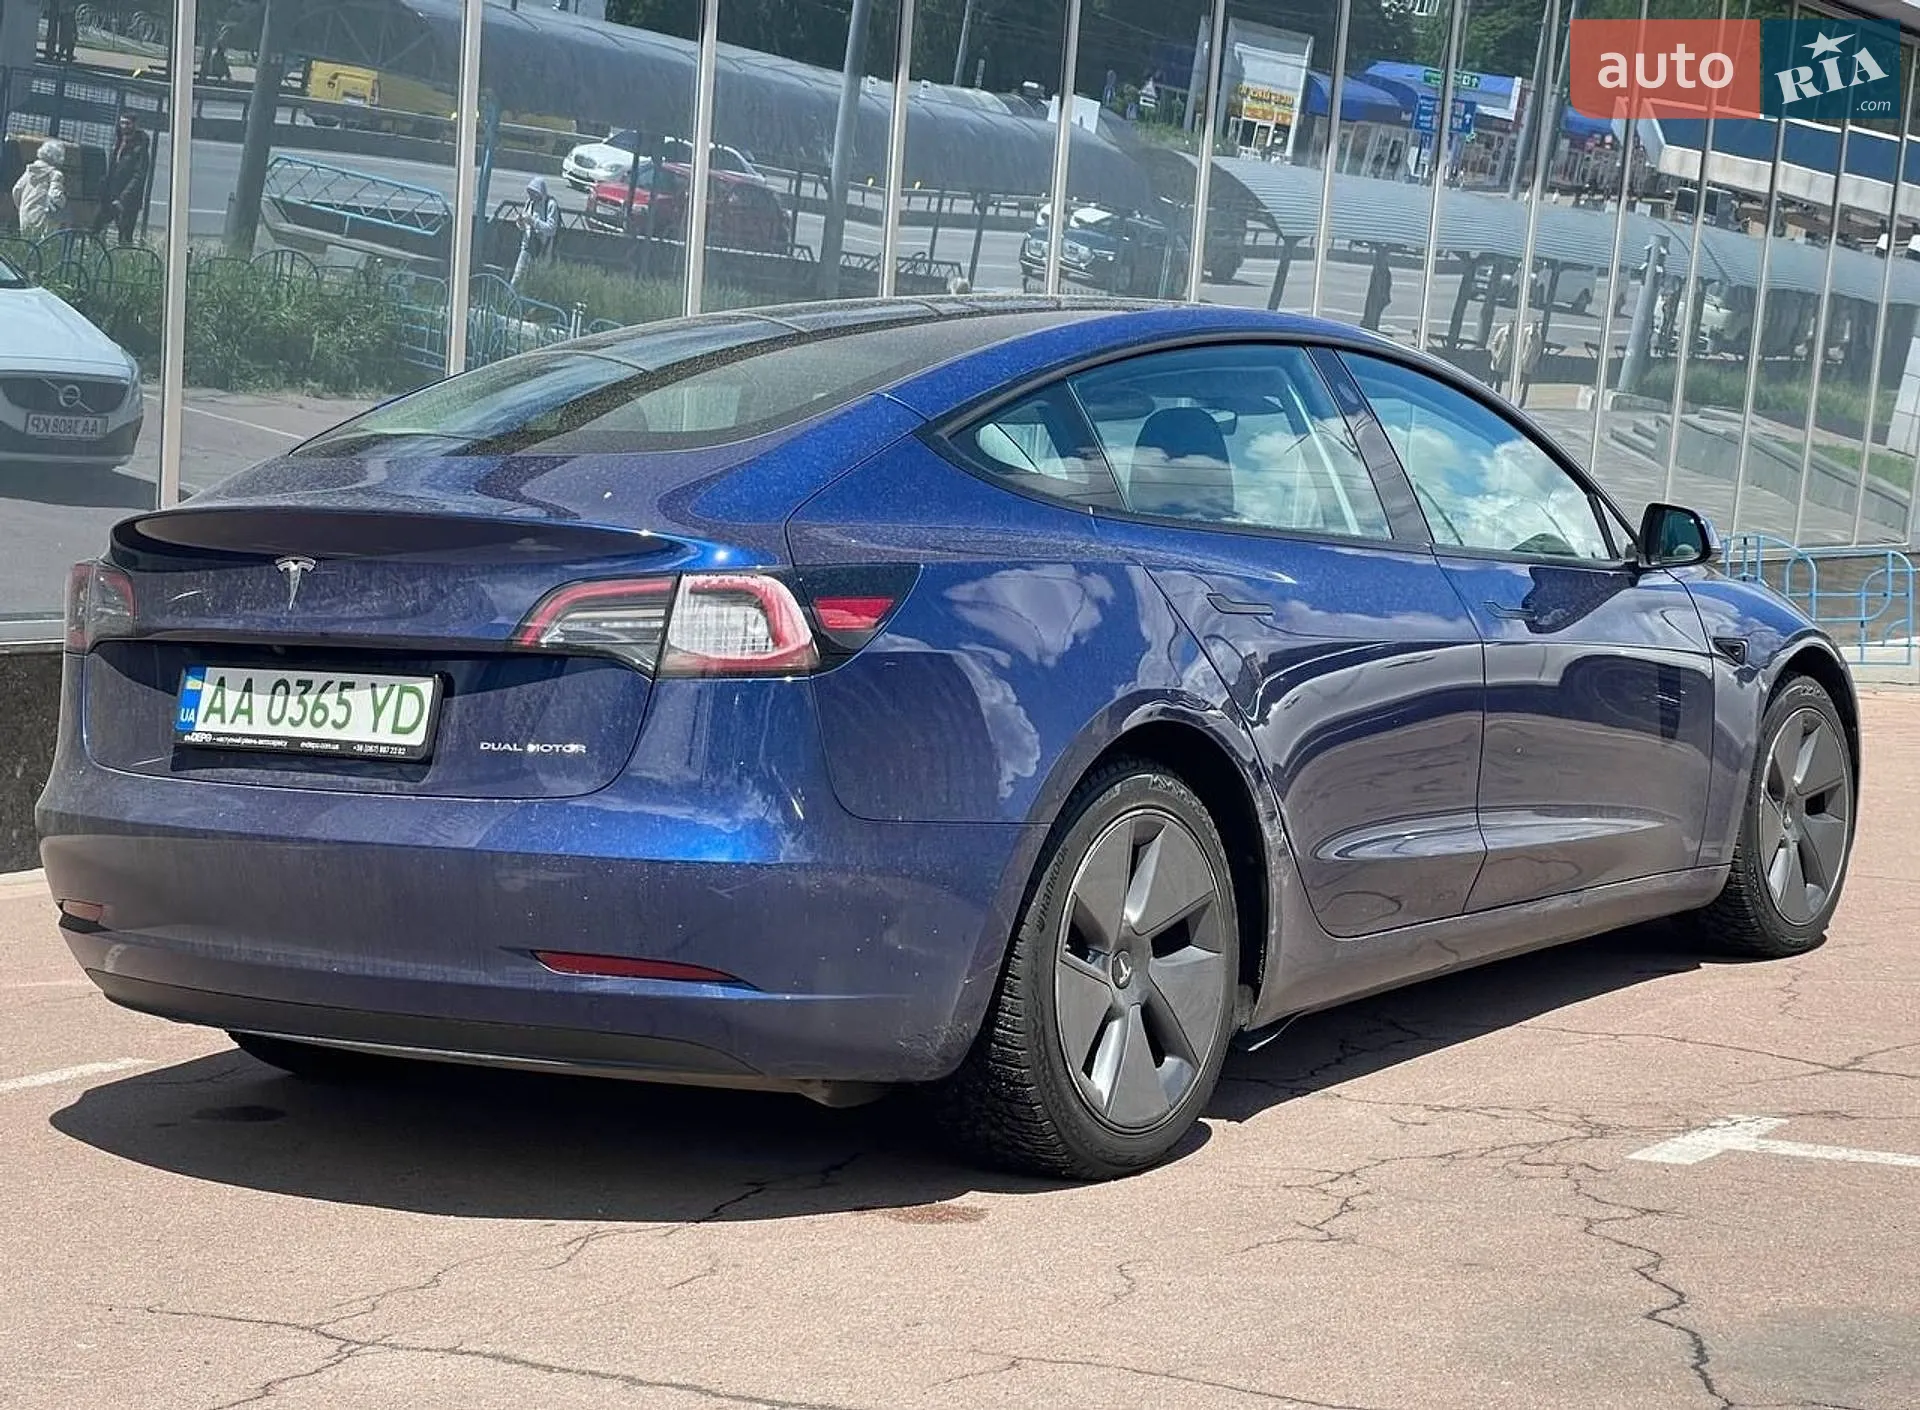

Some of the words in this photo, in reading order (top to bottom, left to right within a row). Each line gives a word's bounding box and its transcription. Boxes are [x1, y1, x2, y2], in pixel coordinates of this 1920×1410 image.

[202, 676, 254, 725] AA
[266, 678, 356, 730] 0365
[369, 682, 426, 735] YD
[180, 707, 195, 723] UA
[480, 741, 523, 752] DUAL
[526, 743, 587, 754] MOTOR
